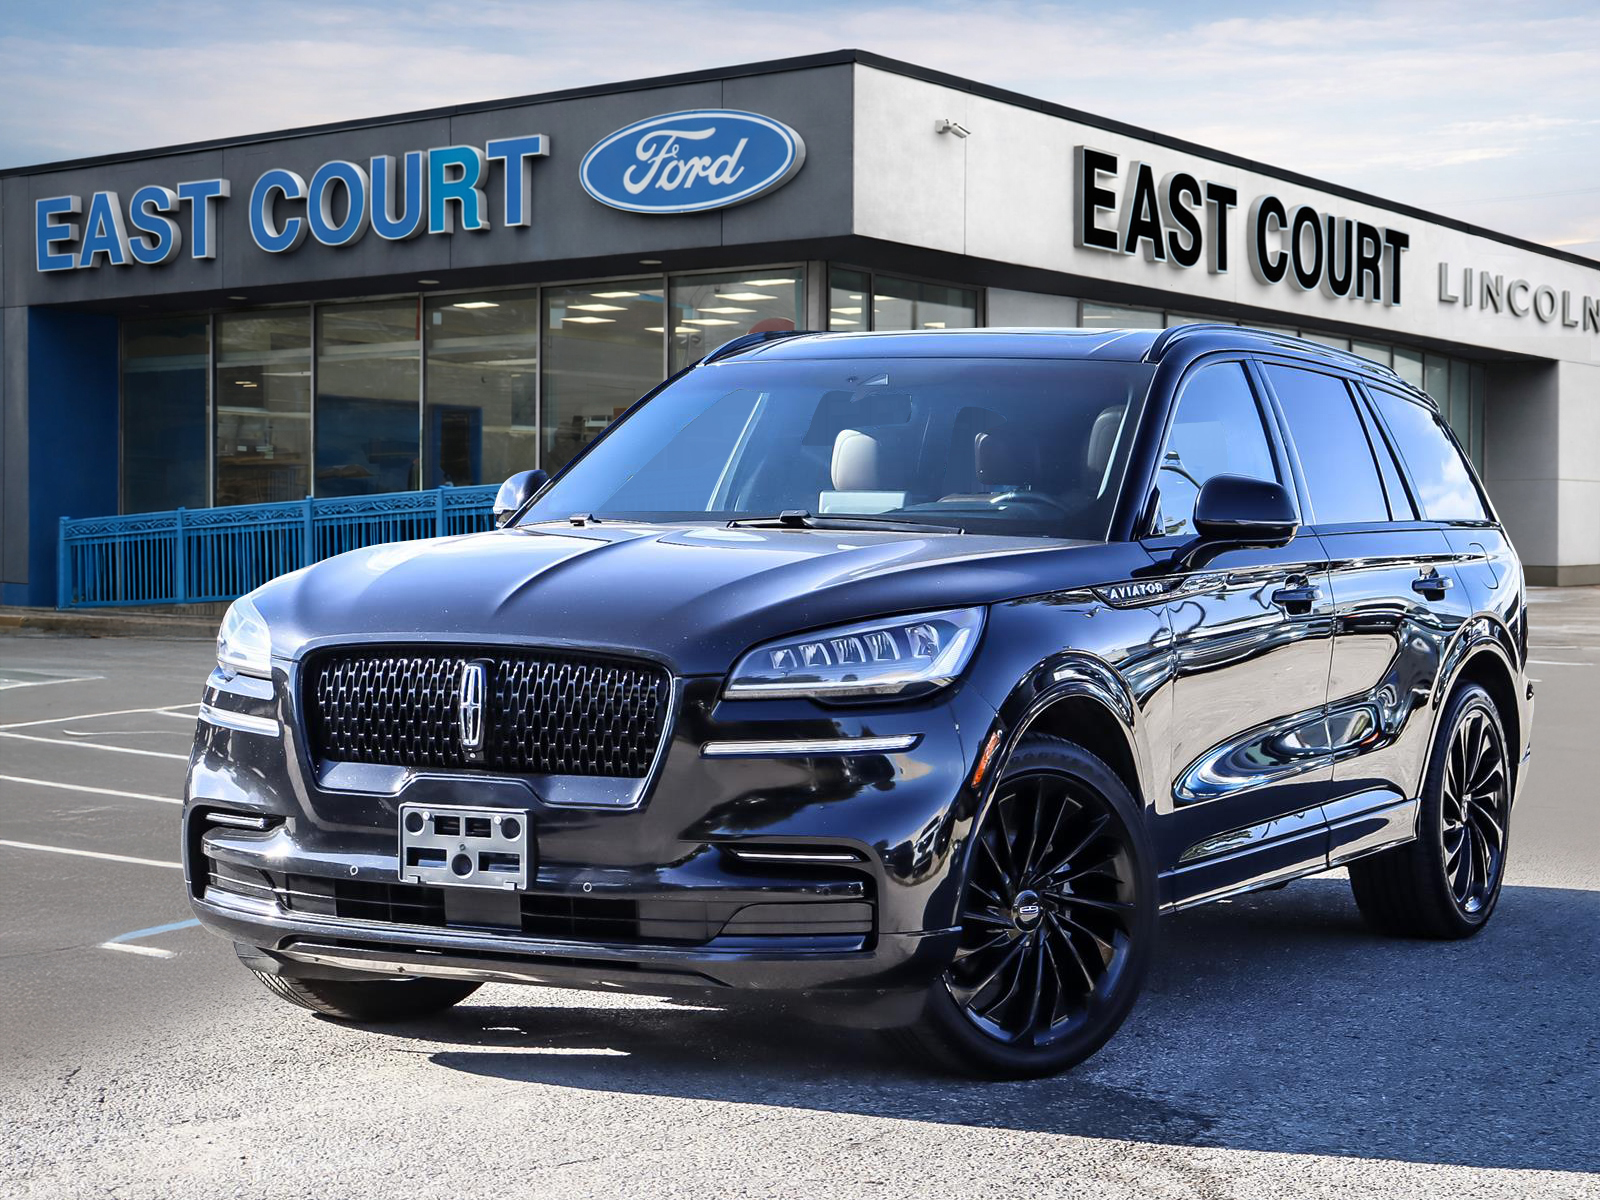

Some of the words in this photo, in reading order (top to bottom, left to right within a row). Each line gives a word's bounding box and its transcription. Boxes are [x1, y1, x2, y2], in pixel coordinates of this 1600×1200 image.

[36, 178, 230, 273] EAST
[248, 133, 550, 254] COURT
[622, 127, 749, 195] Ford
[1074, 145, 1237, 275] EAST
[1247, 194, 1410, 308] COURT
[1110, 582, 1164, 599] AVIATOR
